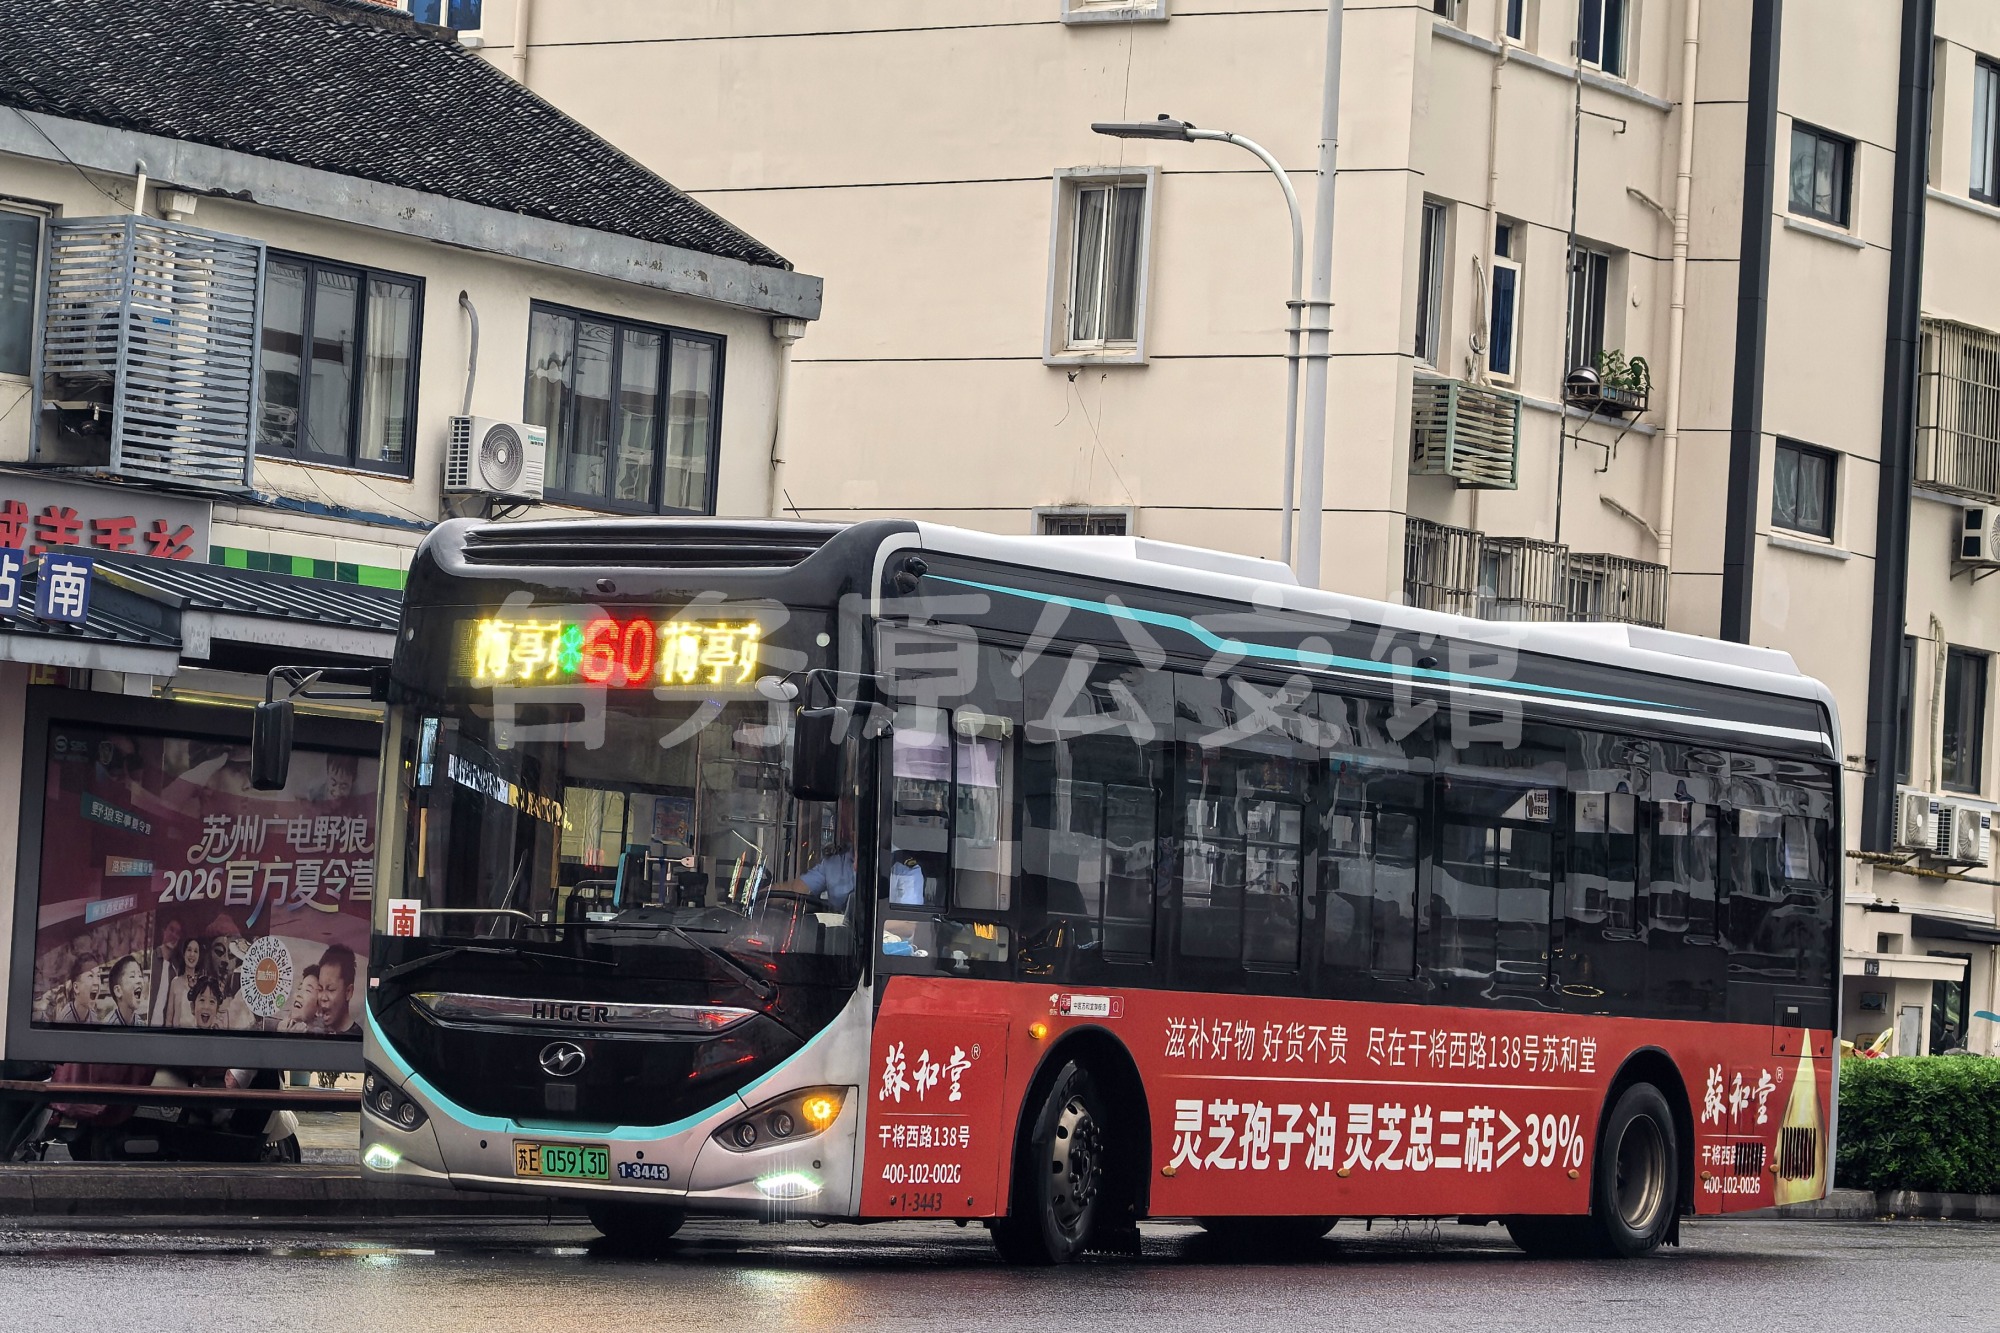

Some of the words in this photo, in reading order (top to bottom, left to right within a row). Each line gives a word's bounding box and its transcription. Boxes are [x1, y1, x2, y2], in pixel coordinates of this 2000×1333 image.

[48, 561, 88, 617] 南
[582, 618, 653, 681] 60
[186, 813, 374, 864] 苏州广电野狼
[158, 855, 374, 929] 2026官方夏令营
[391, 903, 417, 937] 南
[532, 1003, 609, 1023] HIGER
[1164, 1016, 1256, 1061] 滋补好物
[1261, 1020, 1349, 1064] 好货不贵
[1366, 1026, 1597, 1074] 尽在干将西路138号苏和堂
[878, 1124, 971, 1149] 干将西路138号
[1169, 1098, 1337, 1171] 灵芝孢子油
[900, 1192, 943, 1212] 1-3443
[1703, 1176, 1761, 1195] 400-102-0026
